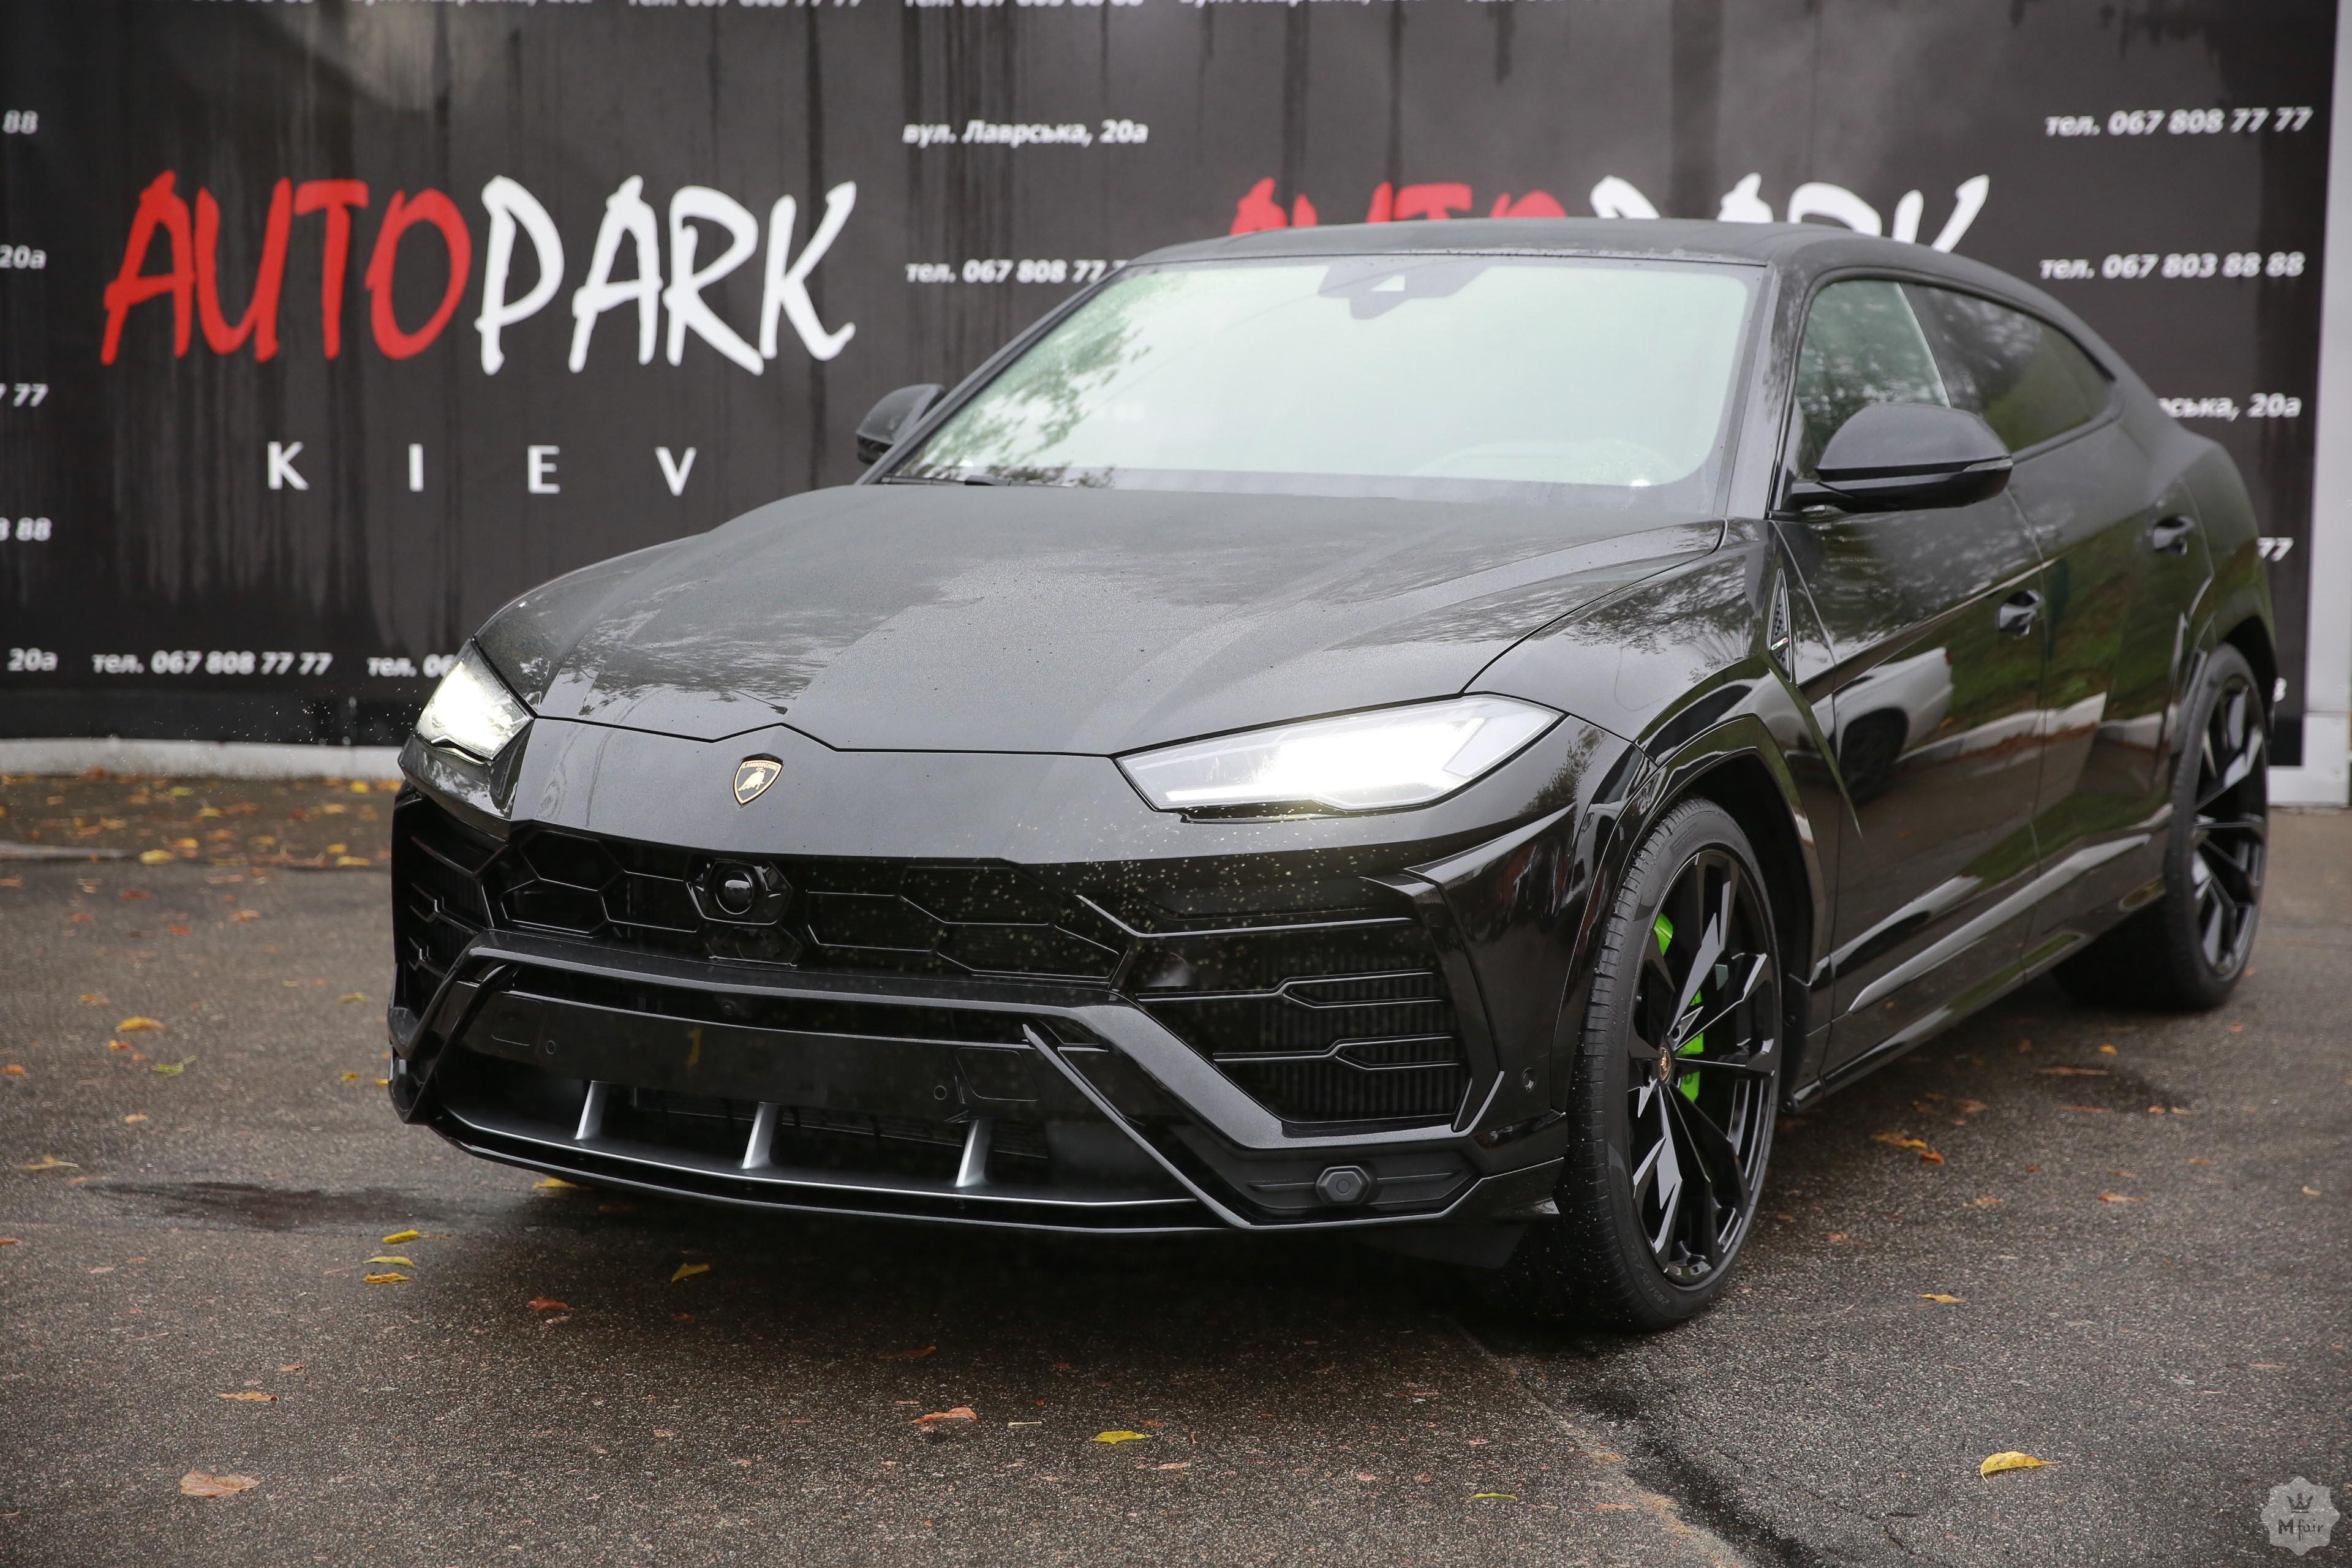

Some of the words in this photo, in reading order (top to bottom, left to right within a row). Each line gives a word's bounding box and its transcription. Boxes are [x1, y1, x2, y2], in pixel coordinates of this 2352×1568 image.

[2045, 115, 2101, 137] тел.
[2108, 110, 2165, 136] 067
[2168, 108, 2225, 135] 808
[2231, 108, 2269, 133] 77
[2275, 107, 2313, 132] 77
[902, 123, 957, 148] вул.
[905, 263, 957, 284] тел.
[962, 258, 1014, 284] 067
[1016, 258, 1068, 284] 808
[1071, 259, 1107, 284] 77
[2040, 258, 2095, 280] тел.
[2101, 254, 2159, 279] 067
[2161, 252, 2218, 279] 803
[2222, 252, 2262, 277] 88
[2266, 252, 2305, 277] 88
[13, 383, 49, 407] 77
[92, 654, 145, 674] тел.
[151, 650, 202, 674] 067
[261, 651, 295, 675] 77
[299, 652, 333, 676] 77
[367, 657, 418, 677] тел.
